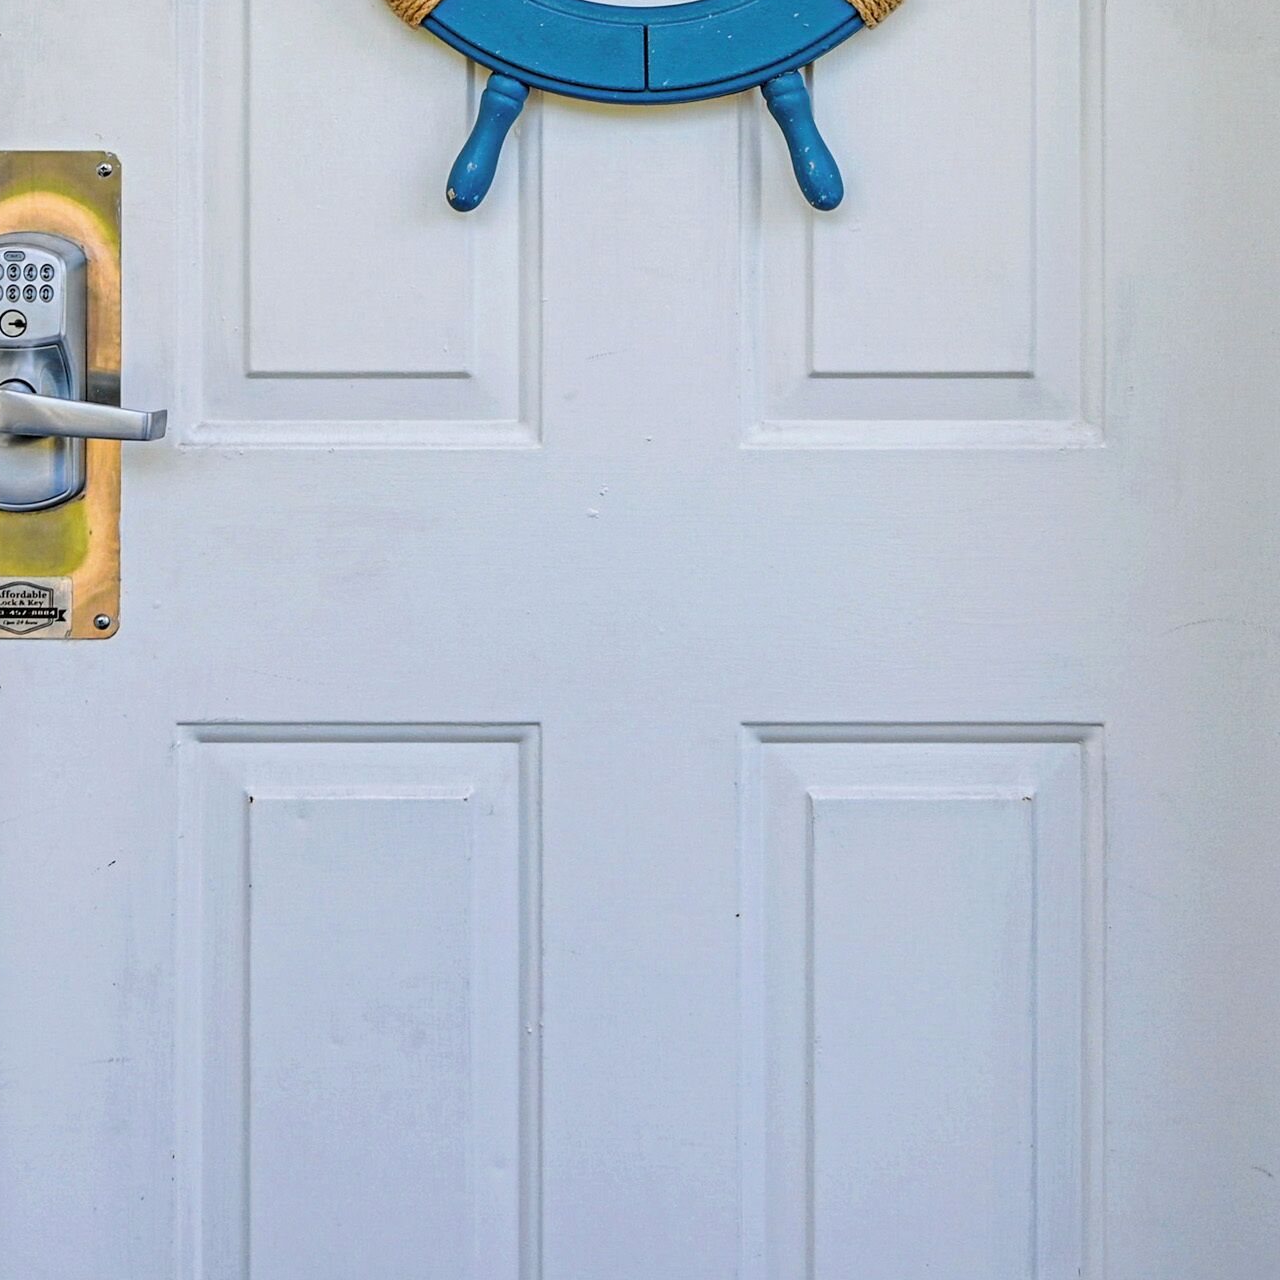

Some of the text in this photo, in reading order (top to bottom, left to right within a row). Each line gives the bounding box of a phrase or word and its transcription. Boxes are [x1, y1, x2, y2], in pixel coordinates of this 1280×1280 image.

[10, 266, 17, 278] 3
[27, 267, 33, 278] 4
[43, 267, 50, 279] 5
[9, 288, 16, 300] 8
[26, 288, 33, 300] 9
[42, 288, 49, 300] 0
[27, 599, 44, 608] Key
